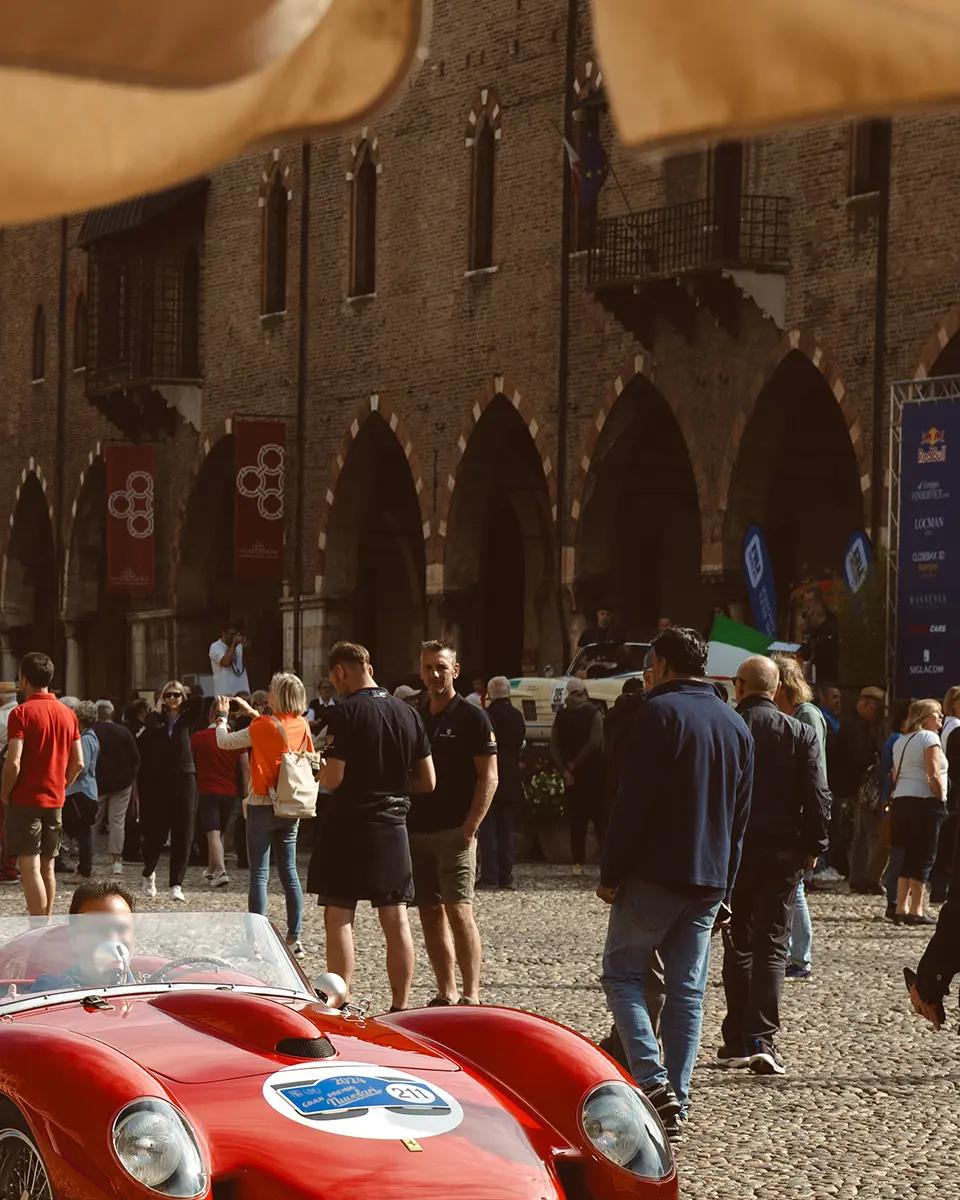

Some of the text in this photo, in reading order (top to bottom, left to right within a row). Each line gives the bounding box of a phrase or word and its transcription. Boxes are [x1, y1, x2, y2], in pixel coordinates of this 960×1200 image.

[914, 517, 944, 530] LOCMAN
[909, 665, 944, 674] SIGLACOM
[335, 1076, 367, 1085] 2024
[391, 1086, 430, 1100] 211
[302, 1096, 325, 1108] GRAN
